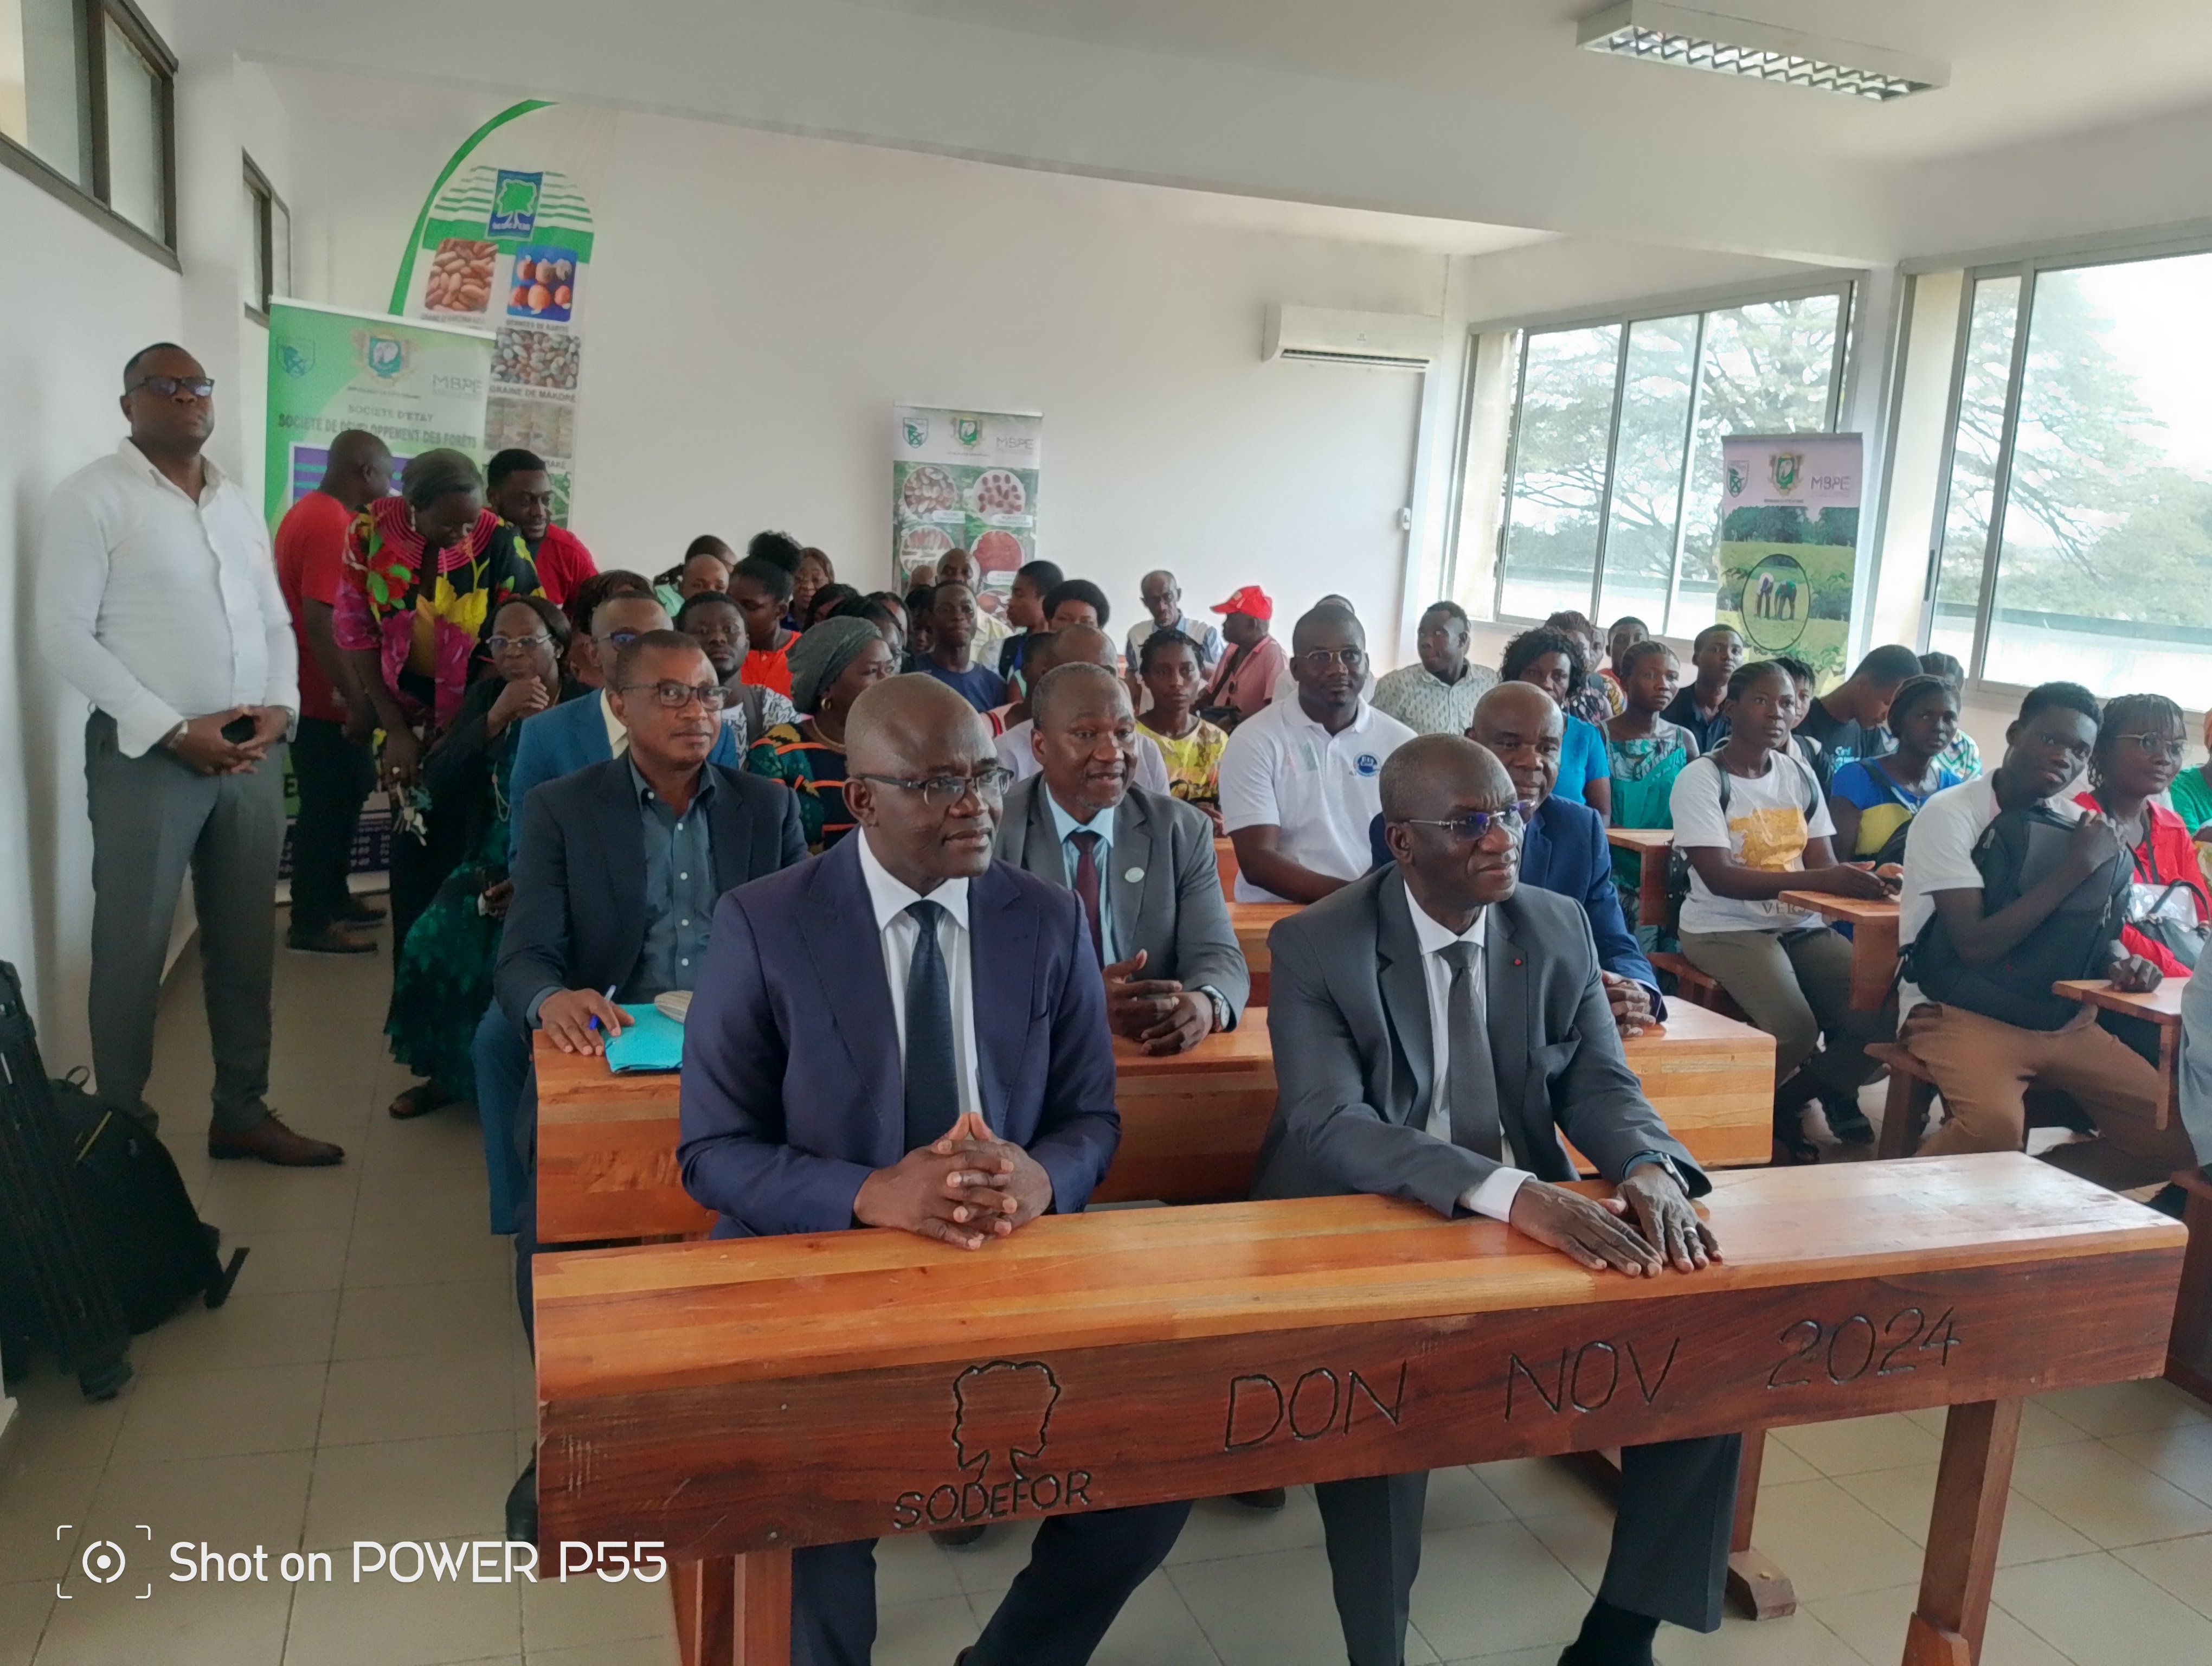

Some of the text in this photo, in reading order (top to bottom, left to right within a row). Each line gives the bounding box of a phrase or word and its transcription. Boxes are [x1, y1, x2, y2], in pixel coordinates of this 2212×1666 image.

[996, 436, 1034, 450] MBPE
[1810, 475, 1850, 490] MBPE
[1224, 1306, 1962, 1452] DON NOV 2024
[893, 1470, 1092, 1530] SODEFOR
